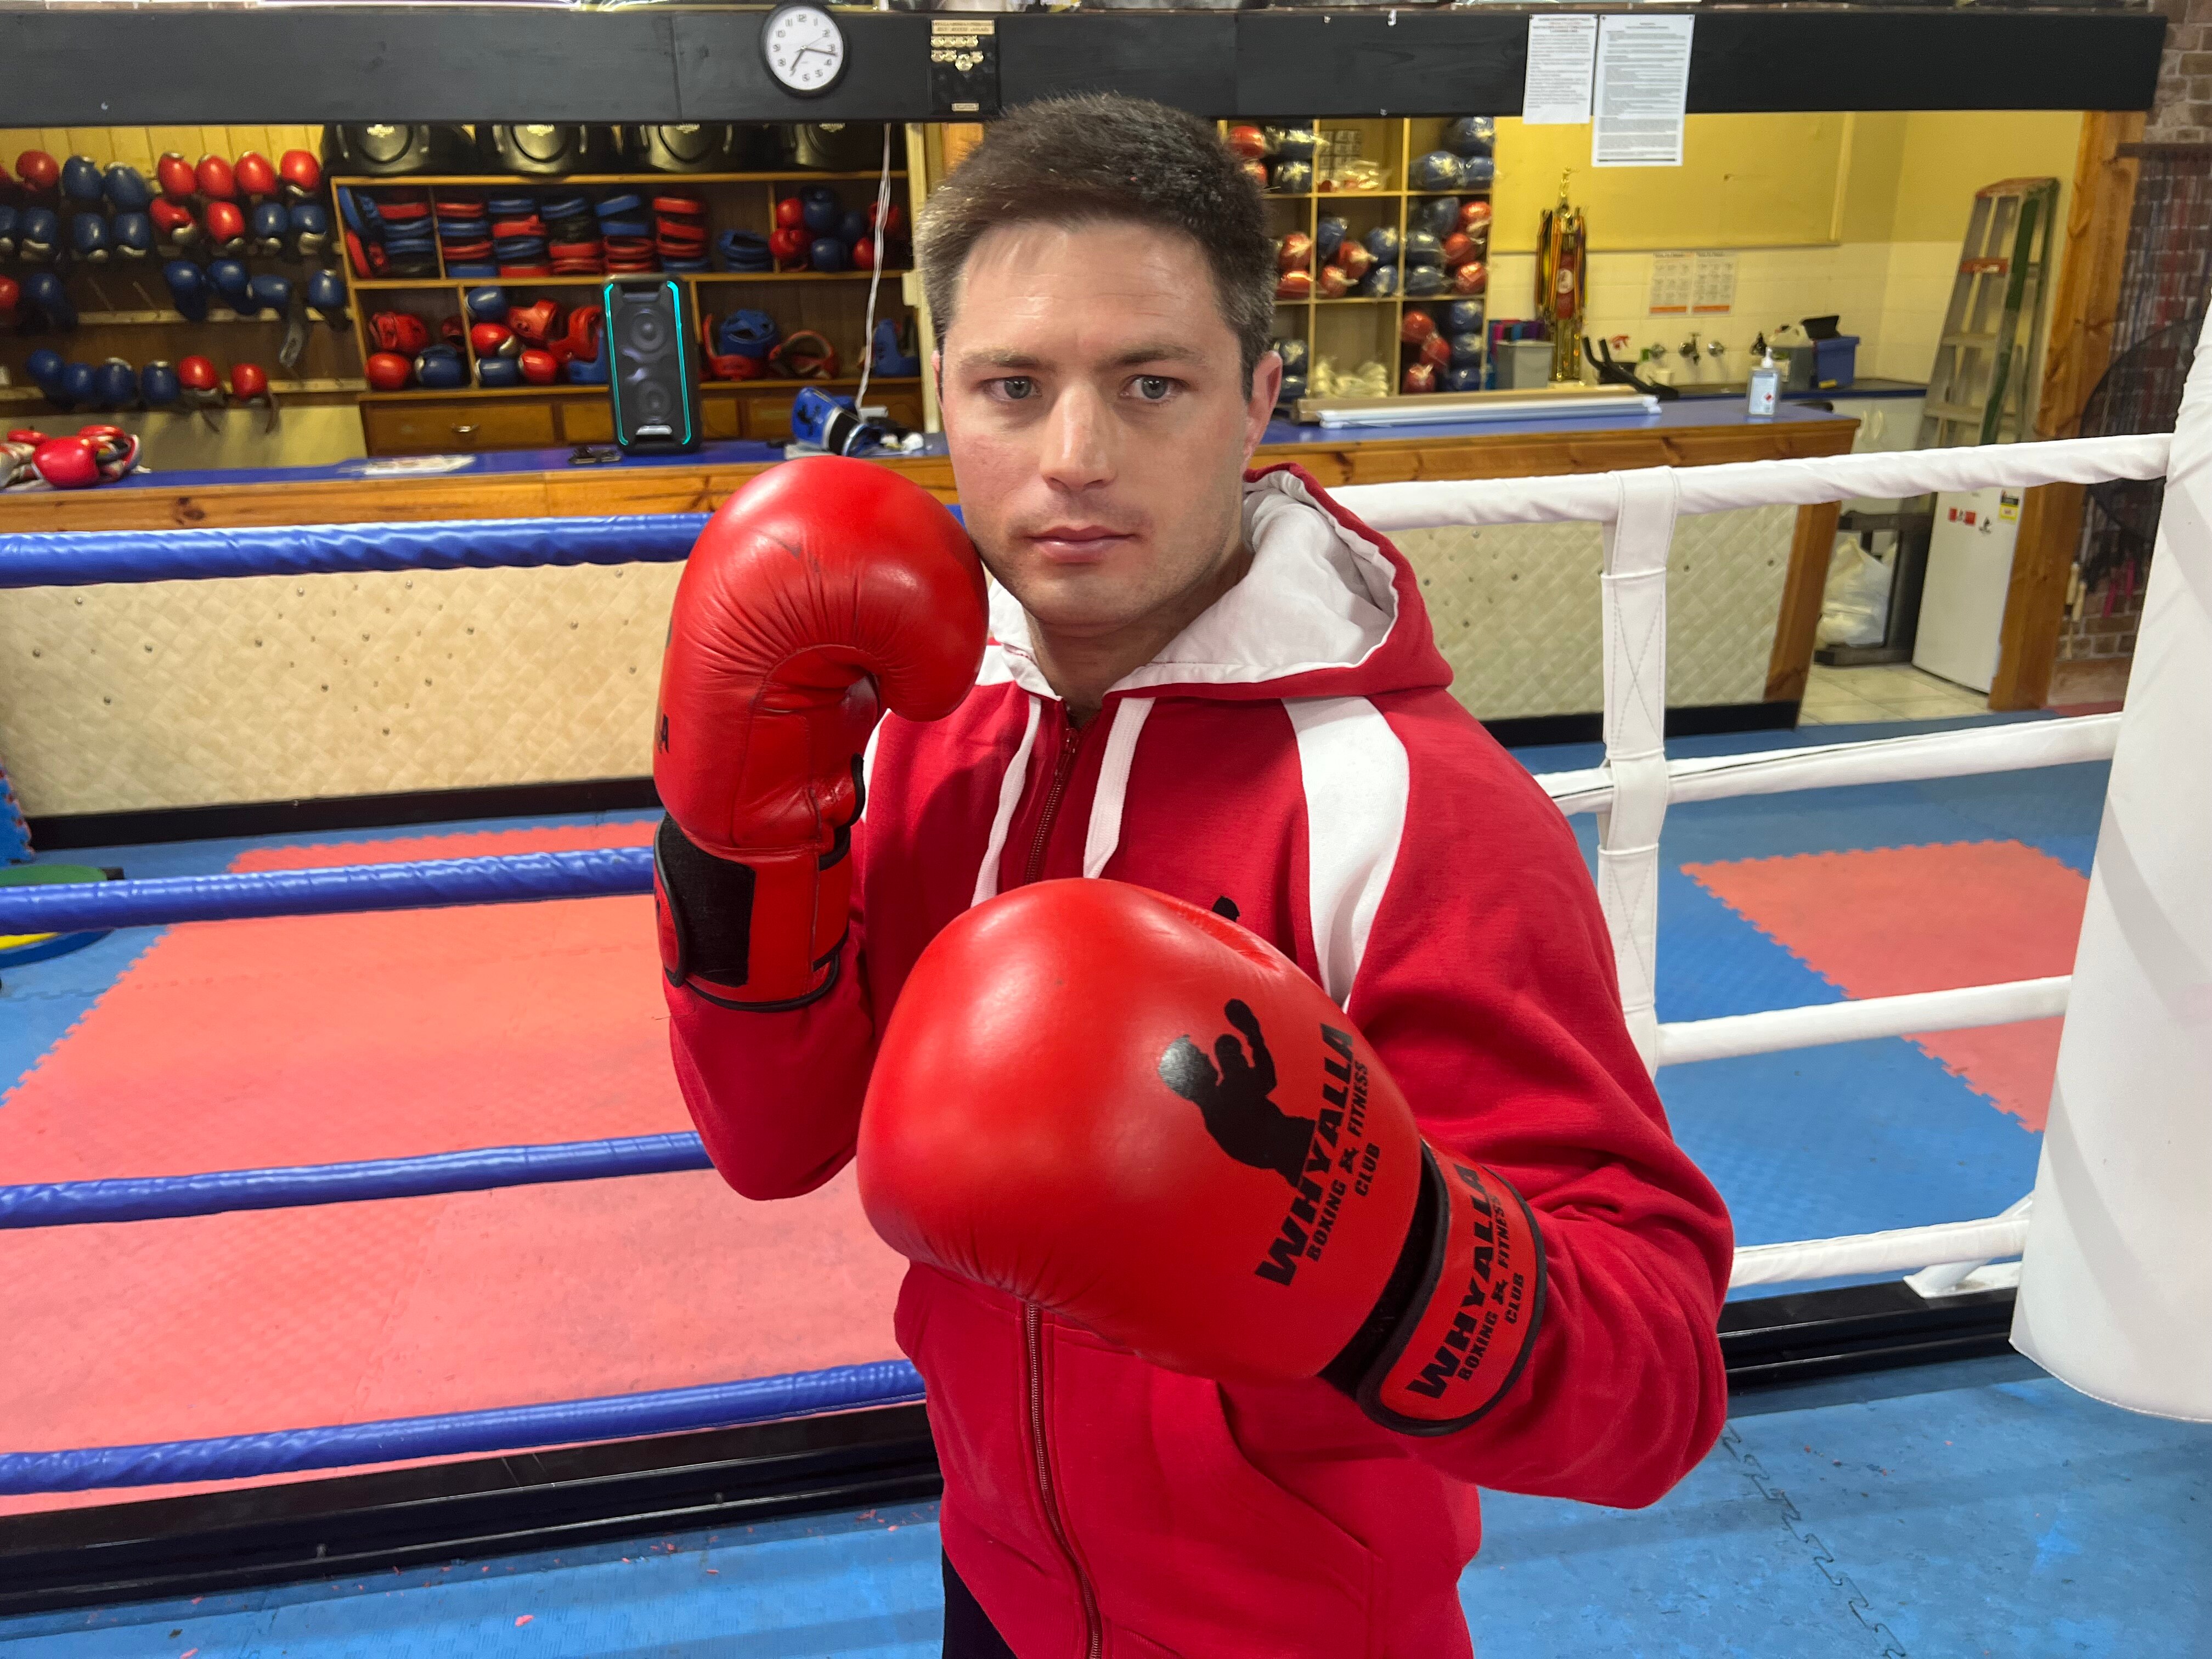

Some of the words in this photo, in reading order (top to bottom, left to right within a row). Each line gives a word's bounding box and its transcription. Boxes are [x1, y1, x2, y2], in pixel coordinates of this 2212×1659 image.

[1255, 1023, 1354, 1286] WHYALLA
[1306, 1178, 1347, 1262] BOXING
[1347, 1060, 1369, 1137] FITNESS
[1354, 1142, 1381, 1197] CLUB
[1404, 1163, 1494, 1399] WHYALLA
[1457, 1311, 1498, 1381] BOXING
[1488, 1194, 1510, 1269] FITNESS
[1504, 1272, 1525, 1325] CLUB
